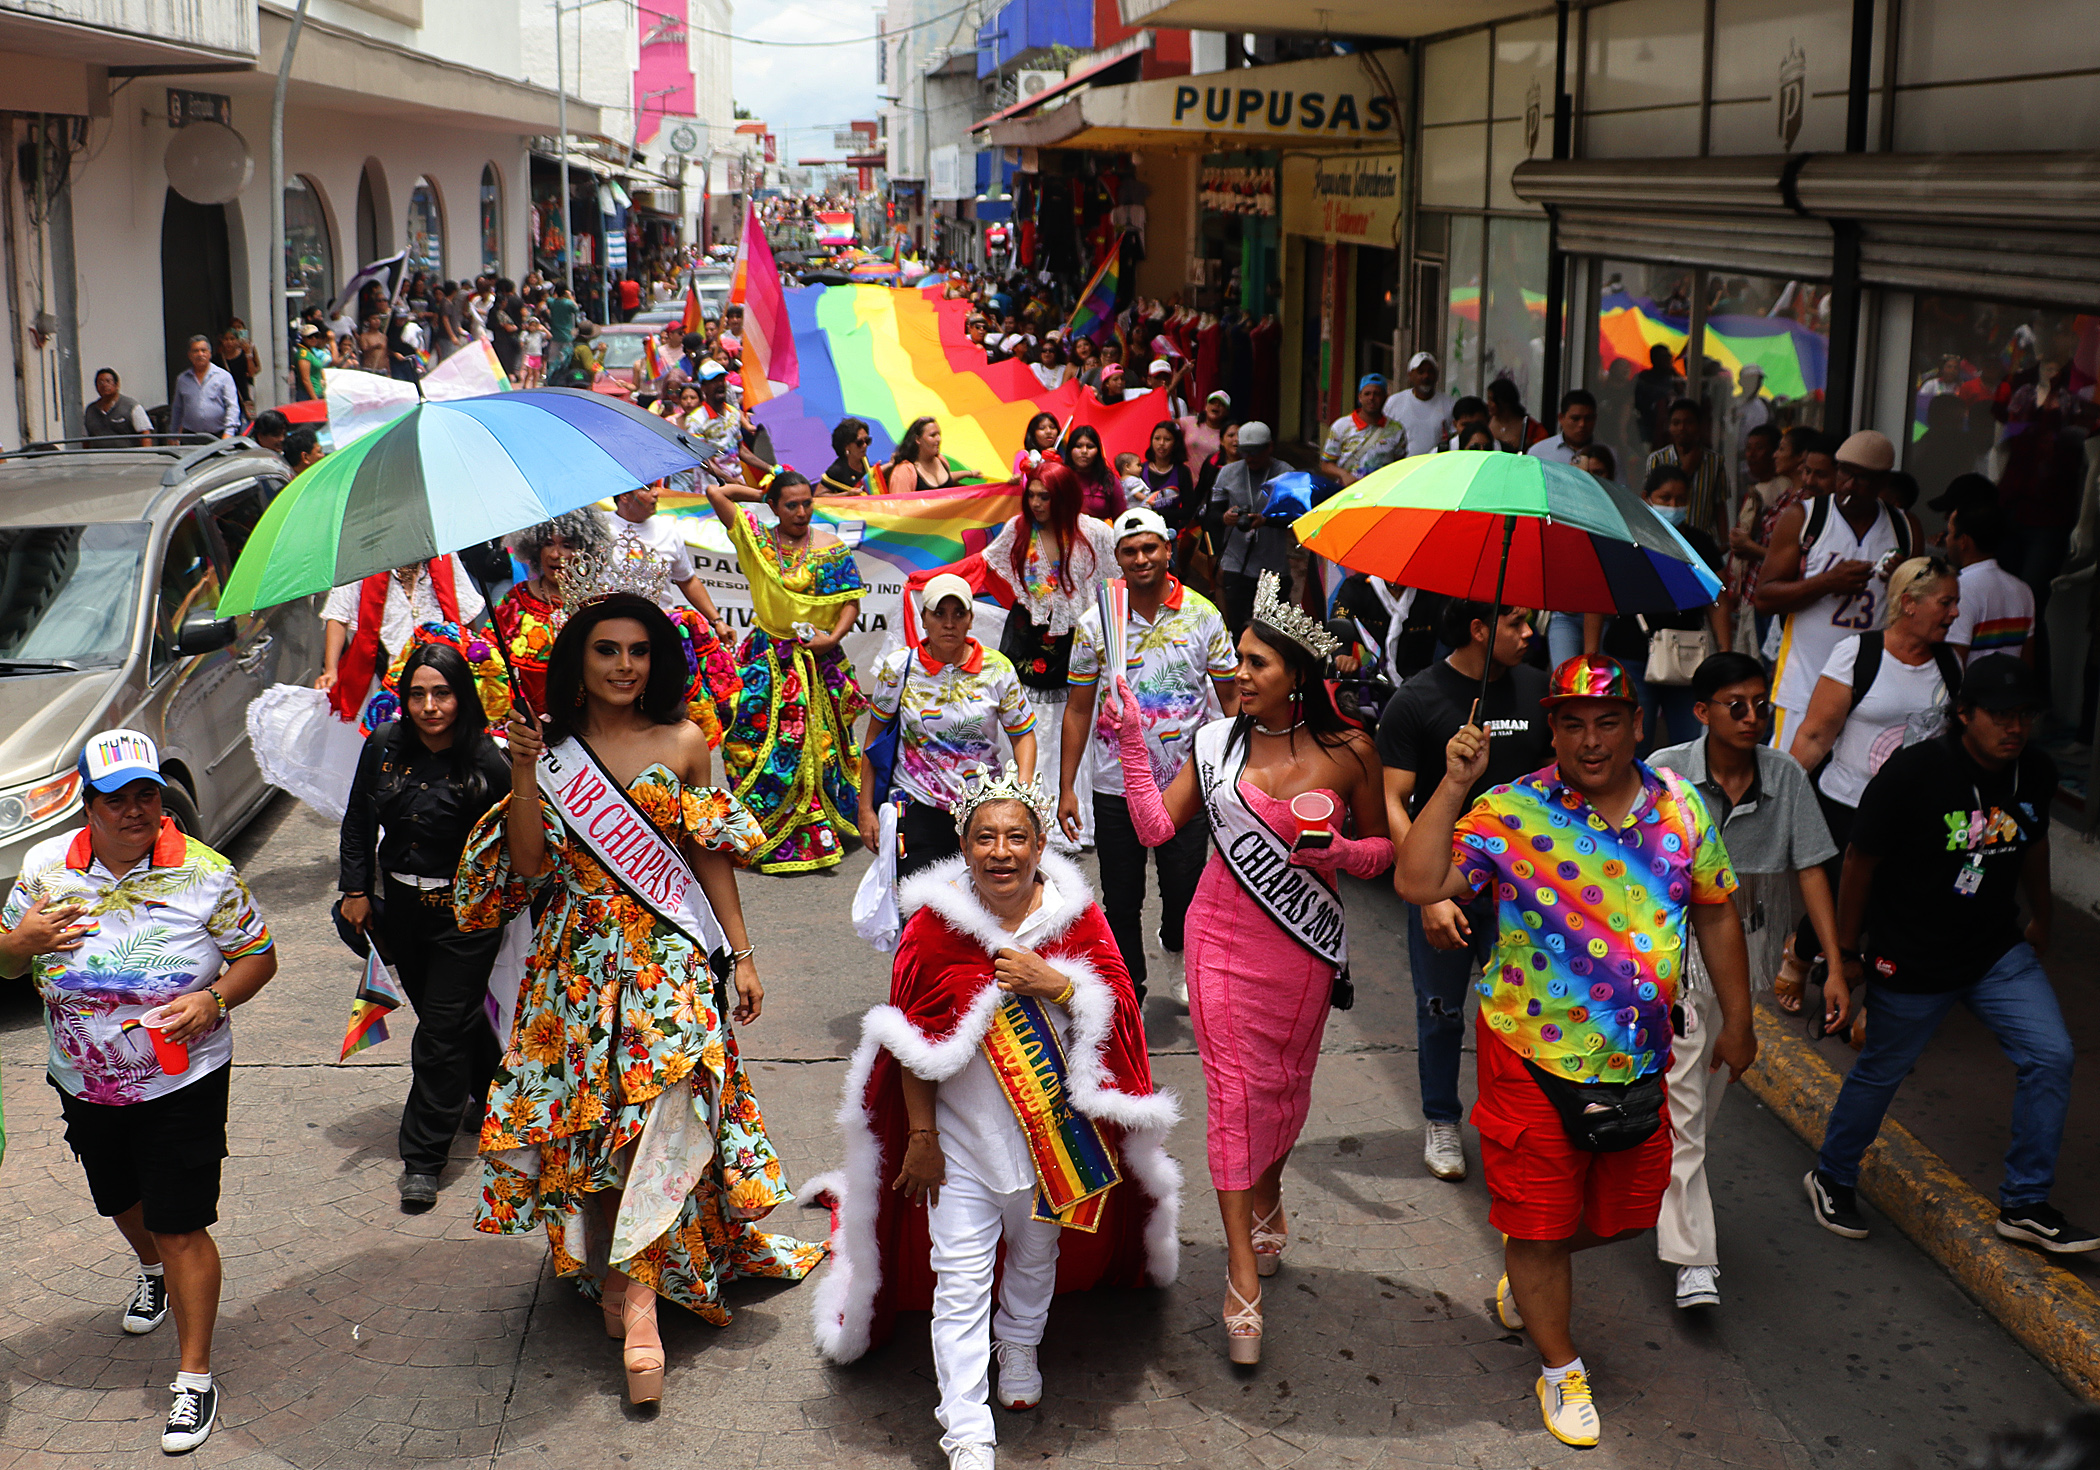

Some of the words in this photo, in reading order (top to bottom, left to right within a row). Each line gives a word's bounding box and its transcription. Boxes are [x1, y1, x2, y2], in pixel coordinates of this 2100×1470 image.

[1172, 85, 1396, 135] PUPUSAS
[1831, 590, 1876, 630] 23
[555, 764, 607, 817] NB
[587, 801, 682, 905] CHIAPAS
[666, 874, 693, 914] 2024
[1229, 831, 1317, 925] CHIAPAS
[1302, 902, 1346, 958] 2024
[1011, 1057, 1066, 1122] LGBT
[1035, 1106, 1075, 1139] 2024
